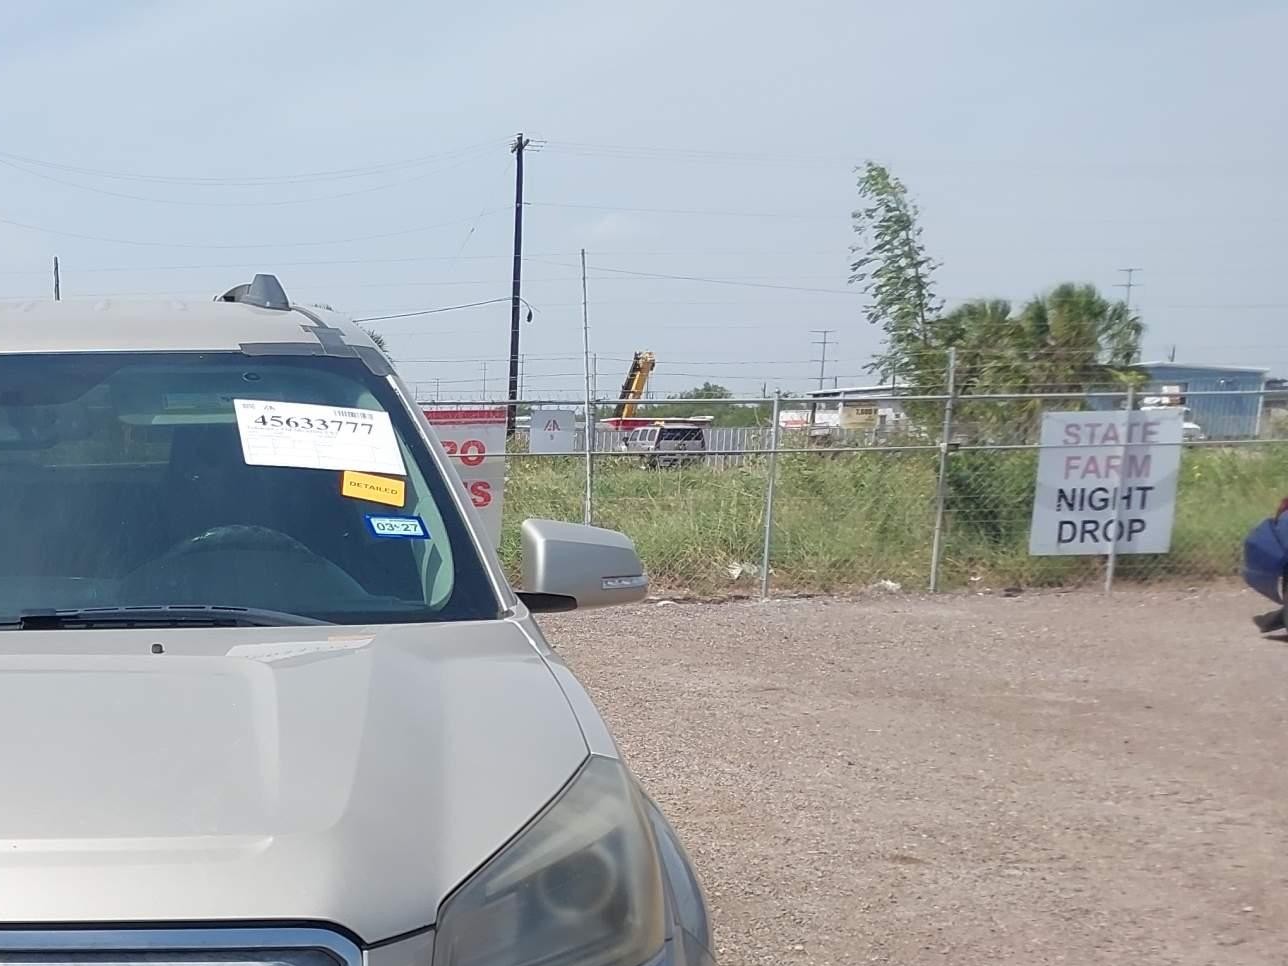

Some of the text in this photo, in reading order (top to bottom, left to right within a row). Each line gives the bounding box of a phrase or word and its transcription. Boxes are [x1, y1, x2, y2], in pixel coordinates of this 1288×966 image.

[254, 414, 373, 435] 45633777
[1063, 422, 1161, 446] STATE
[1063, 455, 1152, 480] FARM
[349, 480, 398, 495] DETAILED
[1056, 486, 1155, 512] NIGHT
[1057, 519, 1146, 544] DROP
